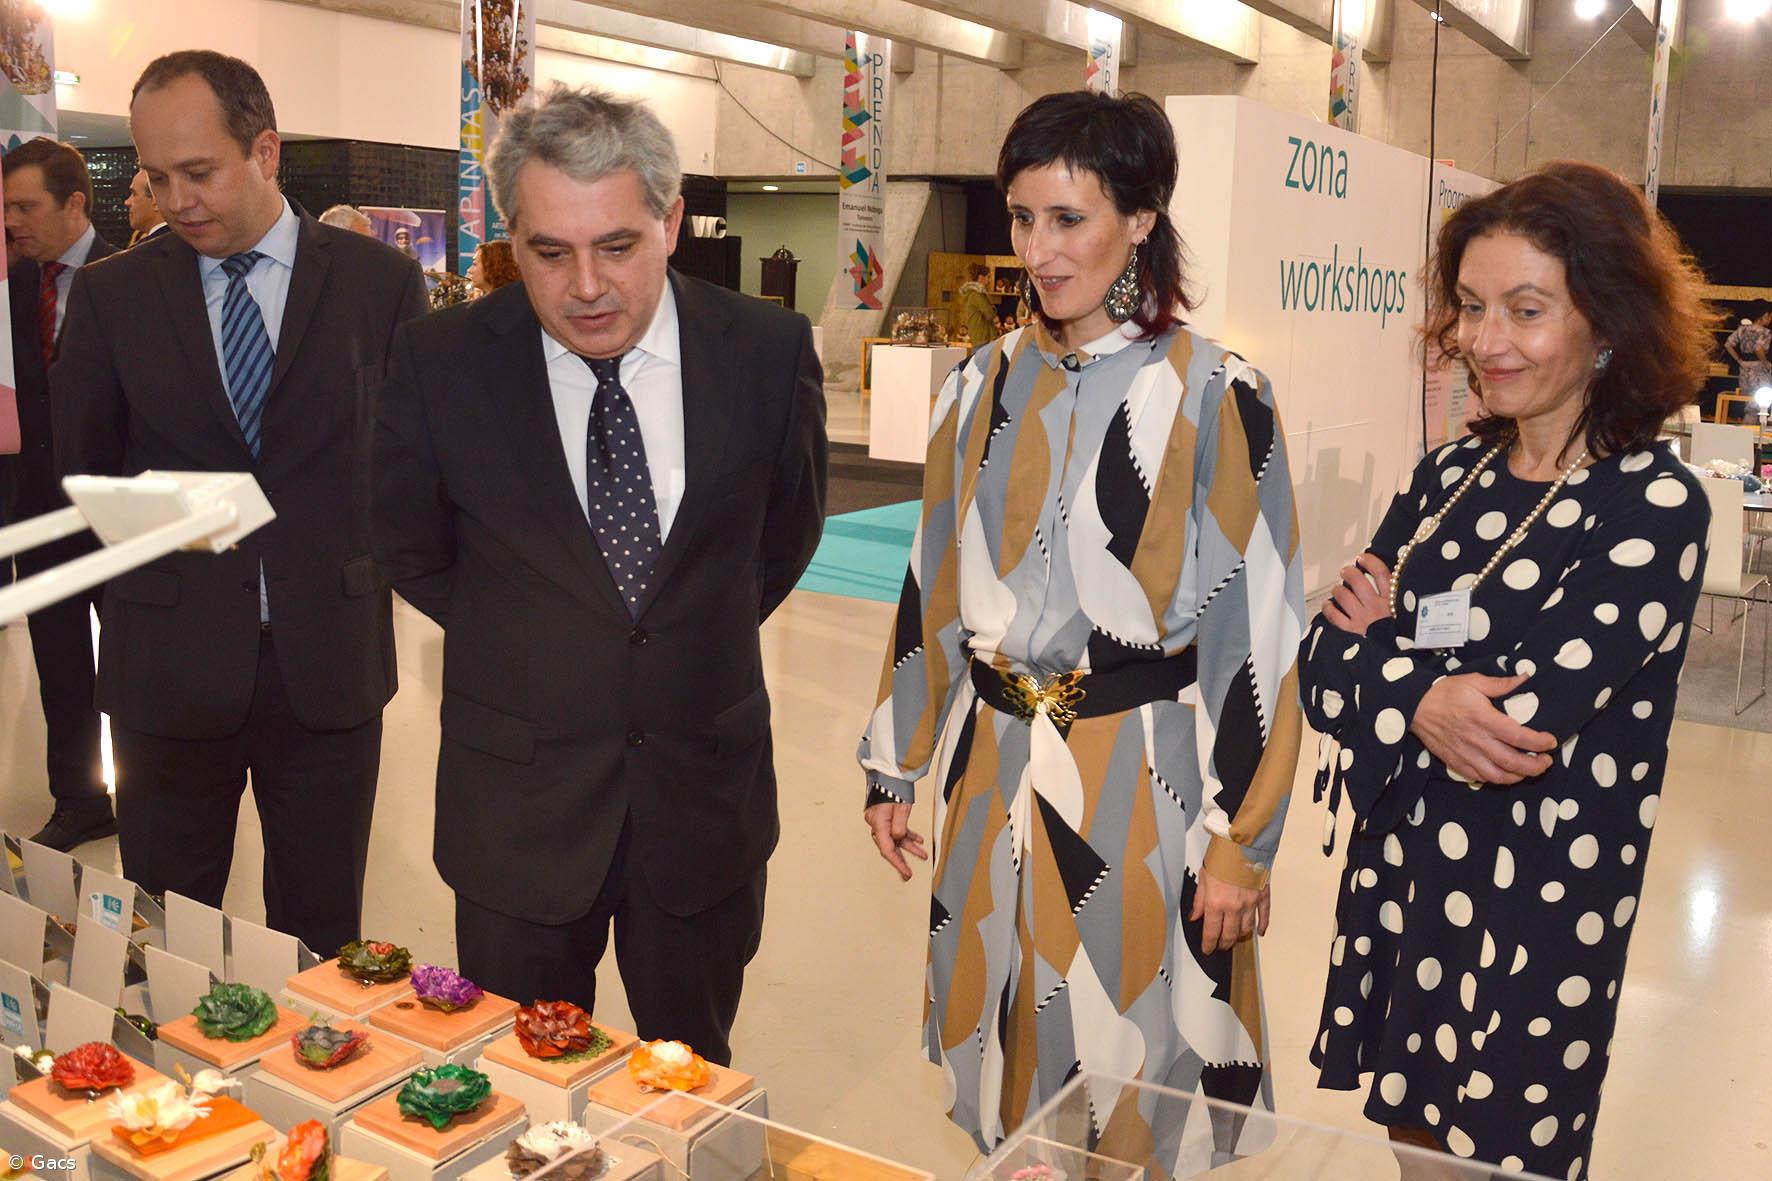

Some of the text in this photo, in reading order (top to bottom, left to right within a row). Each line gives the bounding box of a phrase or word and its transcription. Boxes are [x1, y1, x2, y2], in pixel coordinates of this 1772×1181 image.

[872, 54, 883, 193] PRENDA
[1285, 136, 1348, 199] zona
[1280, 244, 1406, 329] workshops
